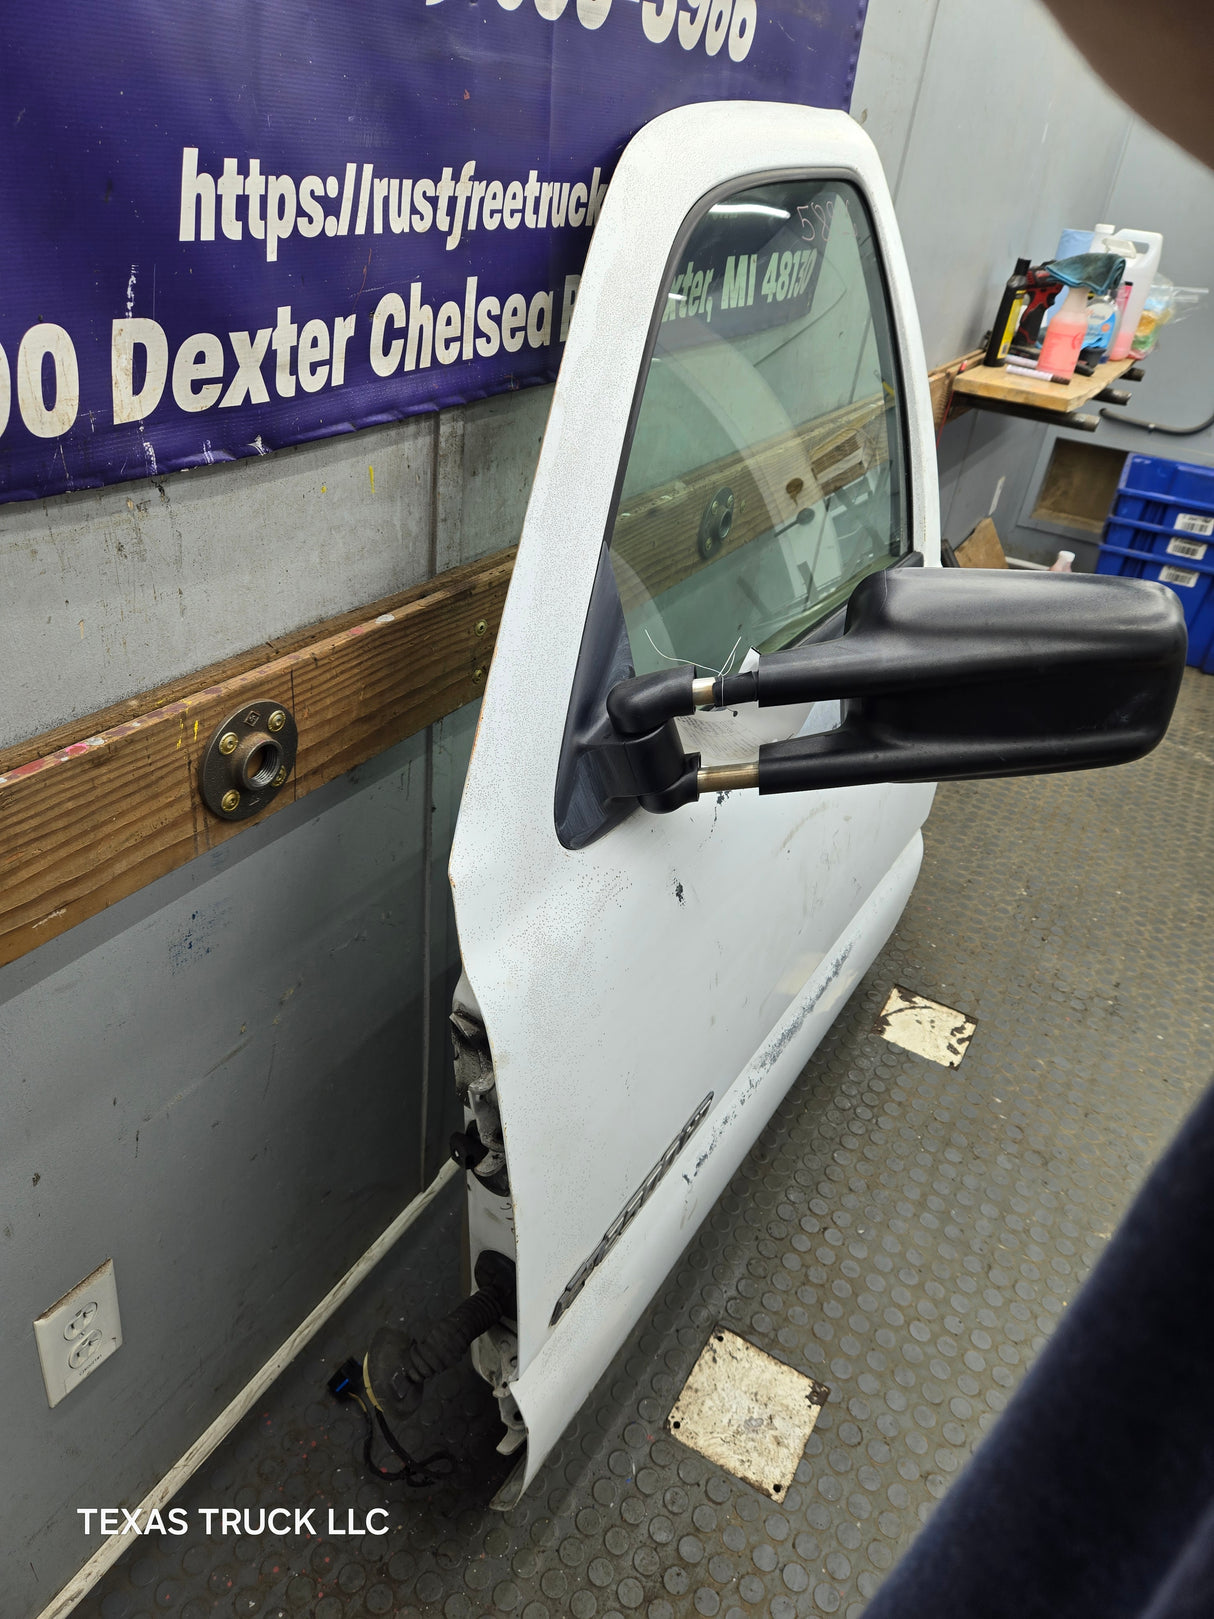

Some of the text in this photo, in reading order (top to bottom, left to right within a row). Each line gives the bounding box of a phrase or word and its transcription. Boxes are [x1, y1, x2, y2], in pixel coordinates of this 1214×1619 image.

[179, 147, 608, 262] https://rustfreetruck
[721, 254, 758, 310] MI
[111, 306, 357, 425] Dexter
[370, 275, 554, 377] Chelsea
